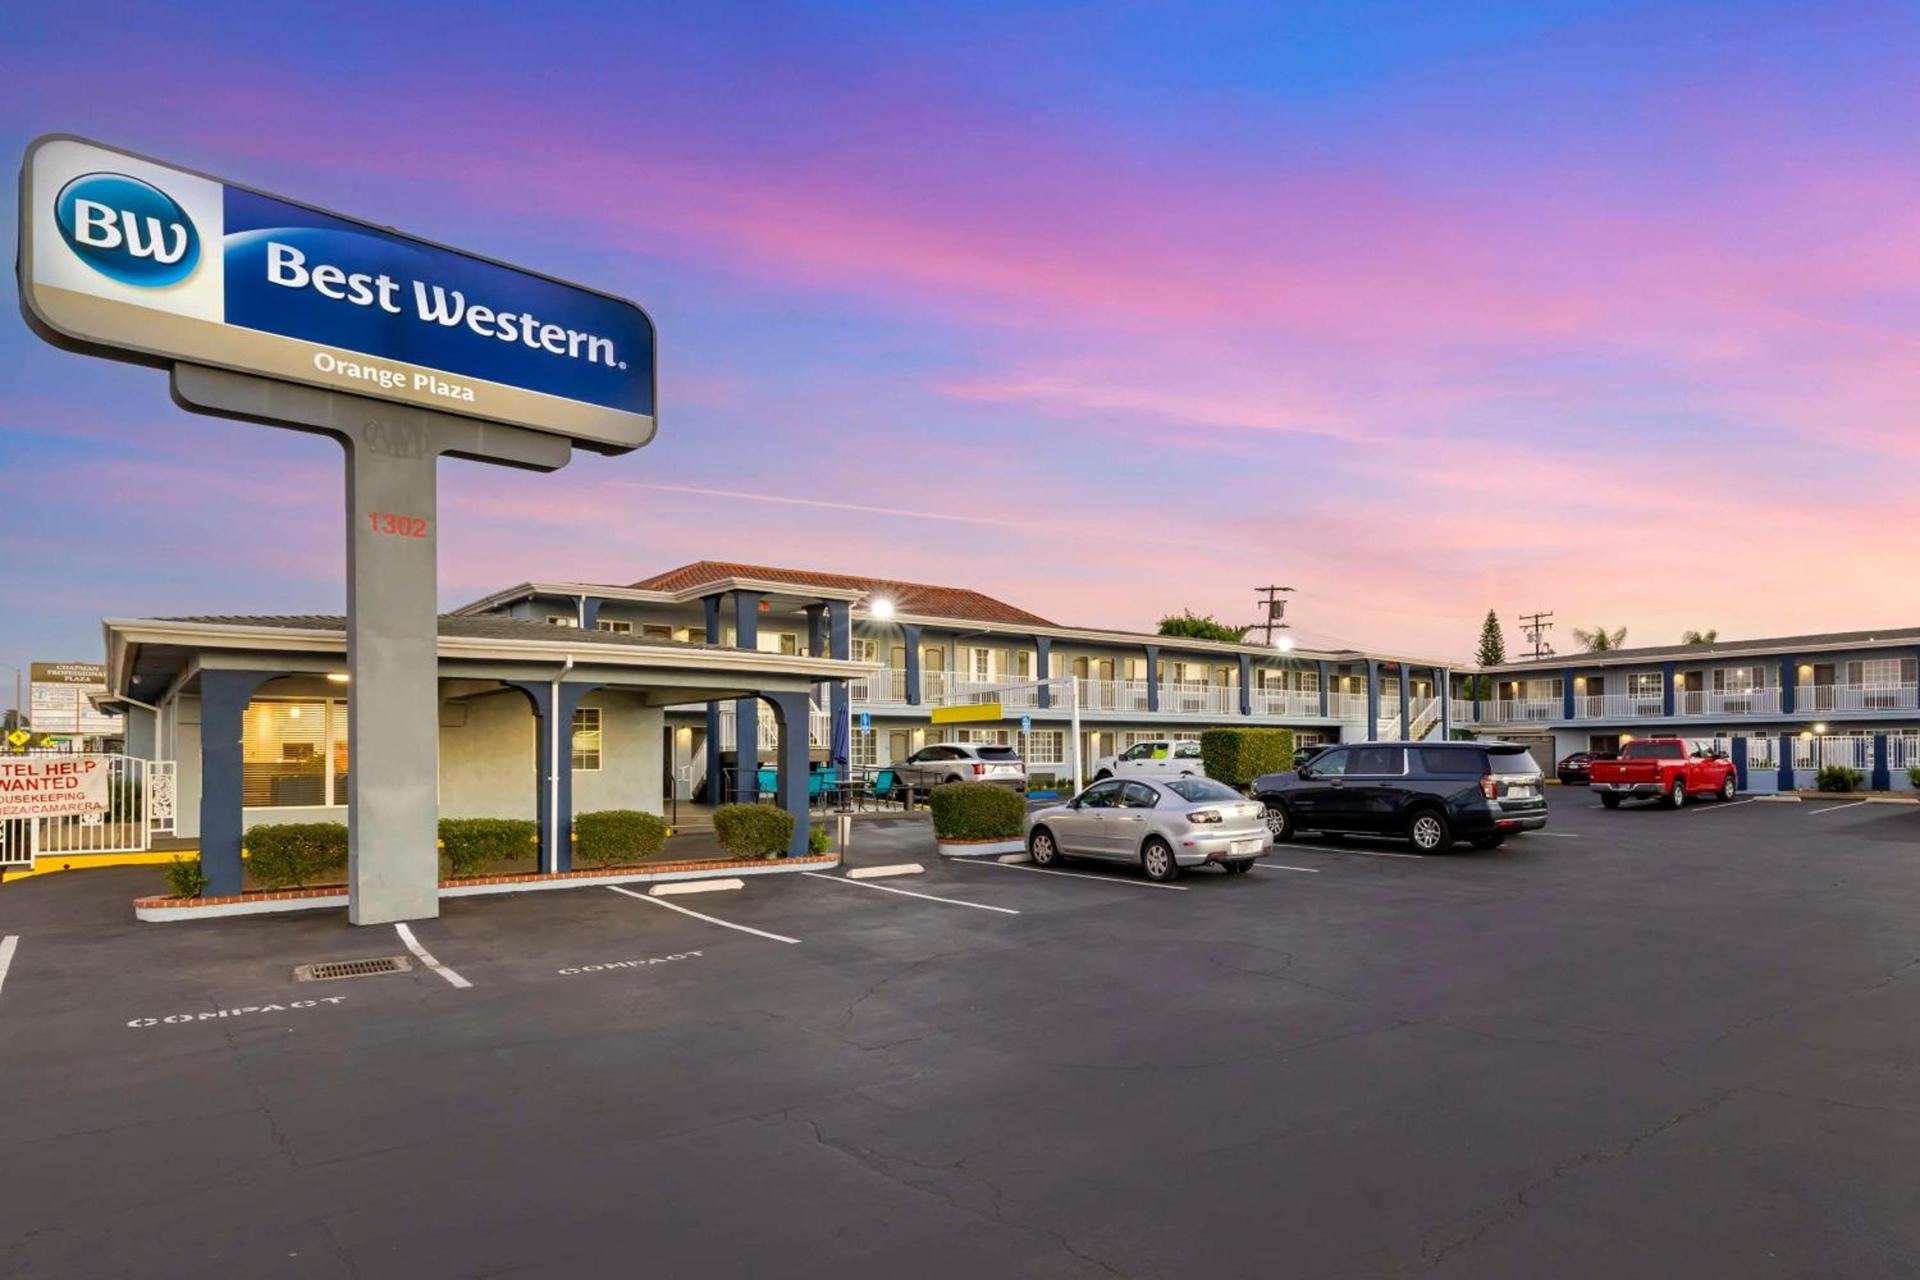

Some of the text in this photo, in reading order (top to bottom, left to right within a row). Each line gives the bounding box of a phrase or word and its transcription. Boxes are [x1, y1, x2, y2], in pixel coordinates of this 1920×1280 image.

[75, 198, 188, 264] BW
[267, 241, 402, 313] Best
[314, 352, 476, 402] Orange Plaza
[368, 511, 427, 538] 1302
[46, 761, 96, 775] HELP
[0, 776, 79, 791] WANTED
[558, 951, 703, 975] COMPACT
[127, 997, 346, 1027] COMPACT
